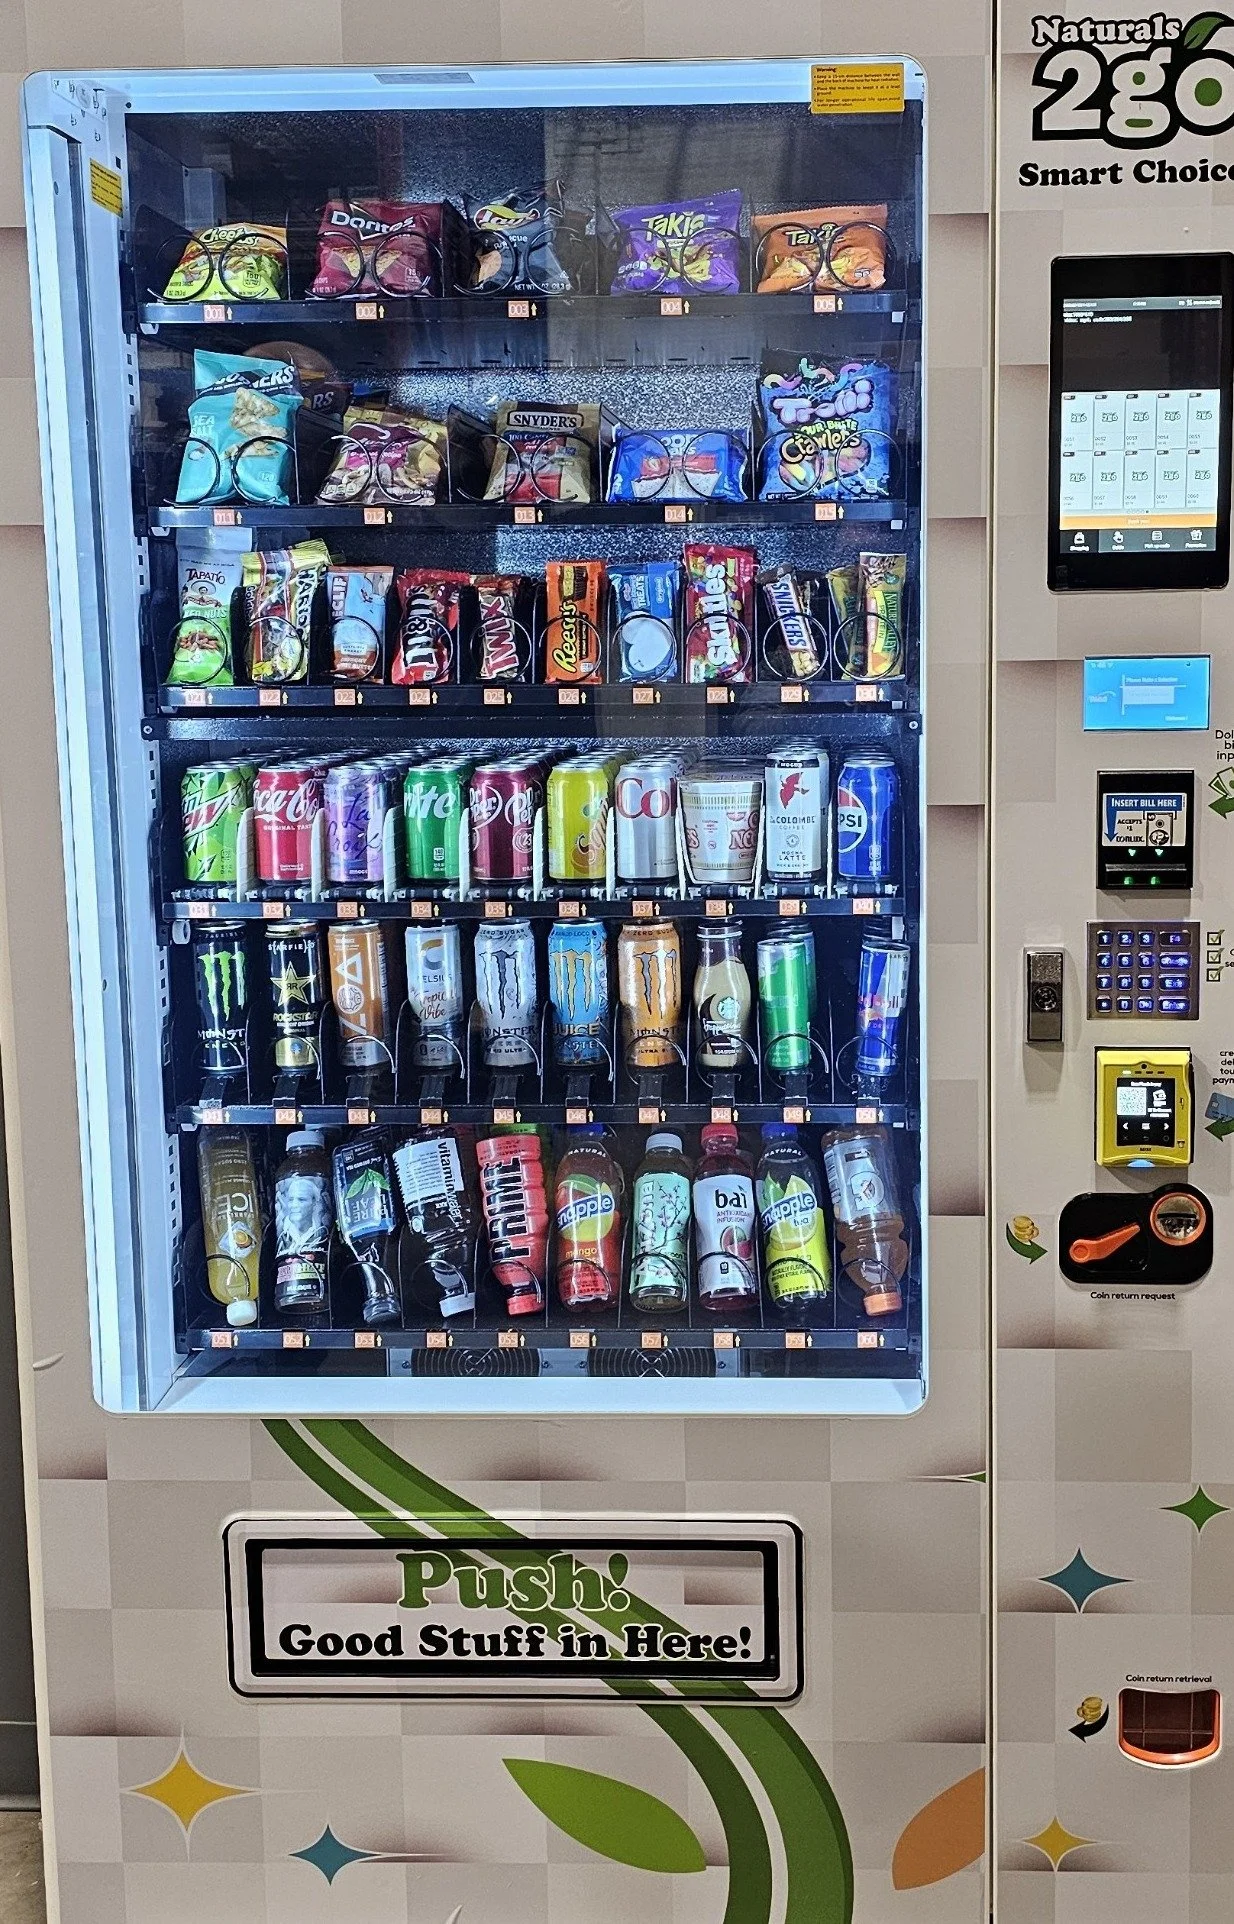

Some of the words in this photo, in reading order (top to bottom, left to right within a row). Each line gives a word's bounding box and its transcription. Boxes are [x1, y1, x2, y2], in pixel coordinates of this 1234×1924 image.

[1032, 13, 1181, 46] Naturals
[1019, 162, 1123, 186] Smart
[331, 210, 414, 233] Doritos
[641, 211, 706, 241] Takis
[662, 301, 681, 312] 004
[815, 298, 834, 309] 005
[205, 308, 224, 318] 001
[357, 306, 376, 316] 002
[509, 304, 528, 314] 003
[773, 378, 872, 423] Trolli
[513, 414, 577, 428] SNYDER'S
[781, 430, 861, 463] Crawlers
[215, 512, 234, 522] 011
[365, 511, 384, 521] 012
[516, 510, 534, 520] 013
[666, 509, 685, 519] 014
[635, 575, 647, 608] TREATS
[700, 564, 737, 666] Skittles
[771, 582, 807, 648] SNICKERS
[480, 597, 520, 679] TWIX
[261, 692, 279, 703] 022
[336, 692, 354, 702] 023
[411, 692, 429, 702] 024
[485, 692, 503, 702] 025
[560, 692, 578, 702] 026
[634, 691, 652, 700] 027
[708, 690, 726, 700] 028
[1111, 797, 1138, 807] INSERT
[1140, 798, 1156, 807] BILL
[1157, 798, 1177, 807] HERE
[264, 905, 282, 915] 032
[412, 905, 430, 914] 034
[486, 905, 504, 914] 035
[560, 905, 578, 914] 036
[634, 904, 652, 913] 037
[1102, 935, 1108, 943] 1
[1122, 935, 1128, 943] 2
[1143, 935, 1150, 943] 3
[1101, 957, 1108, 965] 4
[1101, 978, 1108, 987] 7
[1142, 978, 1149, 987] 9
[277, 1112, 295, 1121] 042
[349, 1112, 367, 1121] 043
[422, 1112, 440, 1121] 044
[495, 1112, 513, 1121] 045
[567, 1112, 585, 1121] 046
[712, 1111, 730, 1120] 048
[784, 1111, 802, 1120] 049
[567, 1147, 607, 1158] NATURAL
[764, 1148, 802, 1157] NATURAL
[438, 1141, 463, 1221] vitaminwater
[715, 1184, 748, 1209] bai
[484, 1157, 531, 1262] PRIME
[1090, 1291, 1110, 1299] Coin
[1140, 1292, 1176, 1301] request
[213, 1335, 231, 1345] 051
[284, 1335, 302, 1345] 052
[356, 1335, 374, 1345] 053
[428, 1335, 446, 1345] 054
[499, 1335, 517, 1345] 055
[571, 1335, 589, 1345] 056
[643, 1335, 661, 1345] 057
[715, 1335, 733, 1345] 058
[858, 1335, 876, 1345] 060
[397, 1551, 631, 1611] Push!
[279, 1624, 402, 1658] Good
[418, 1624, 550, 1659] Stuff
[557, 1624, 609, 1660] in
[621, 1625, 754, 1660] Here!
[1125, 1674, 1145, 1682] Coin
[1175, 1674, 1212, 1683] retrieval
